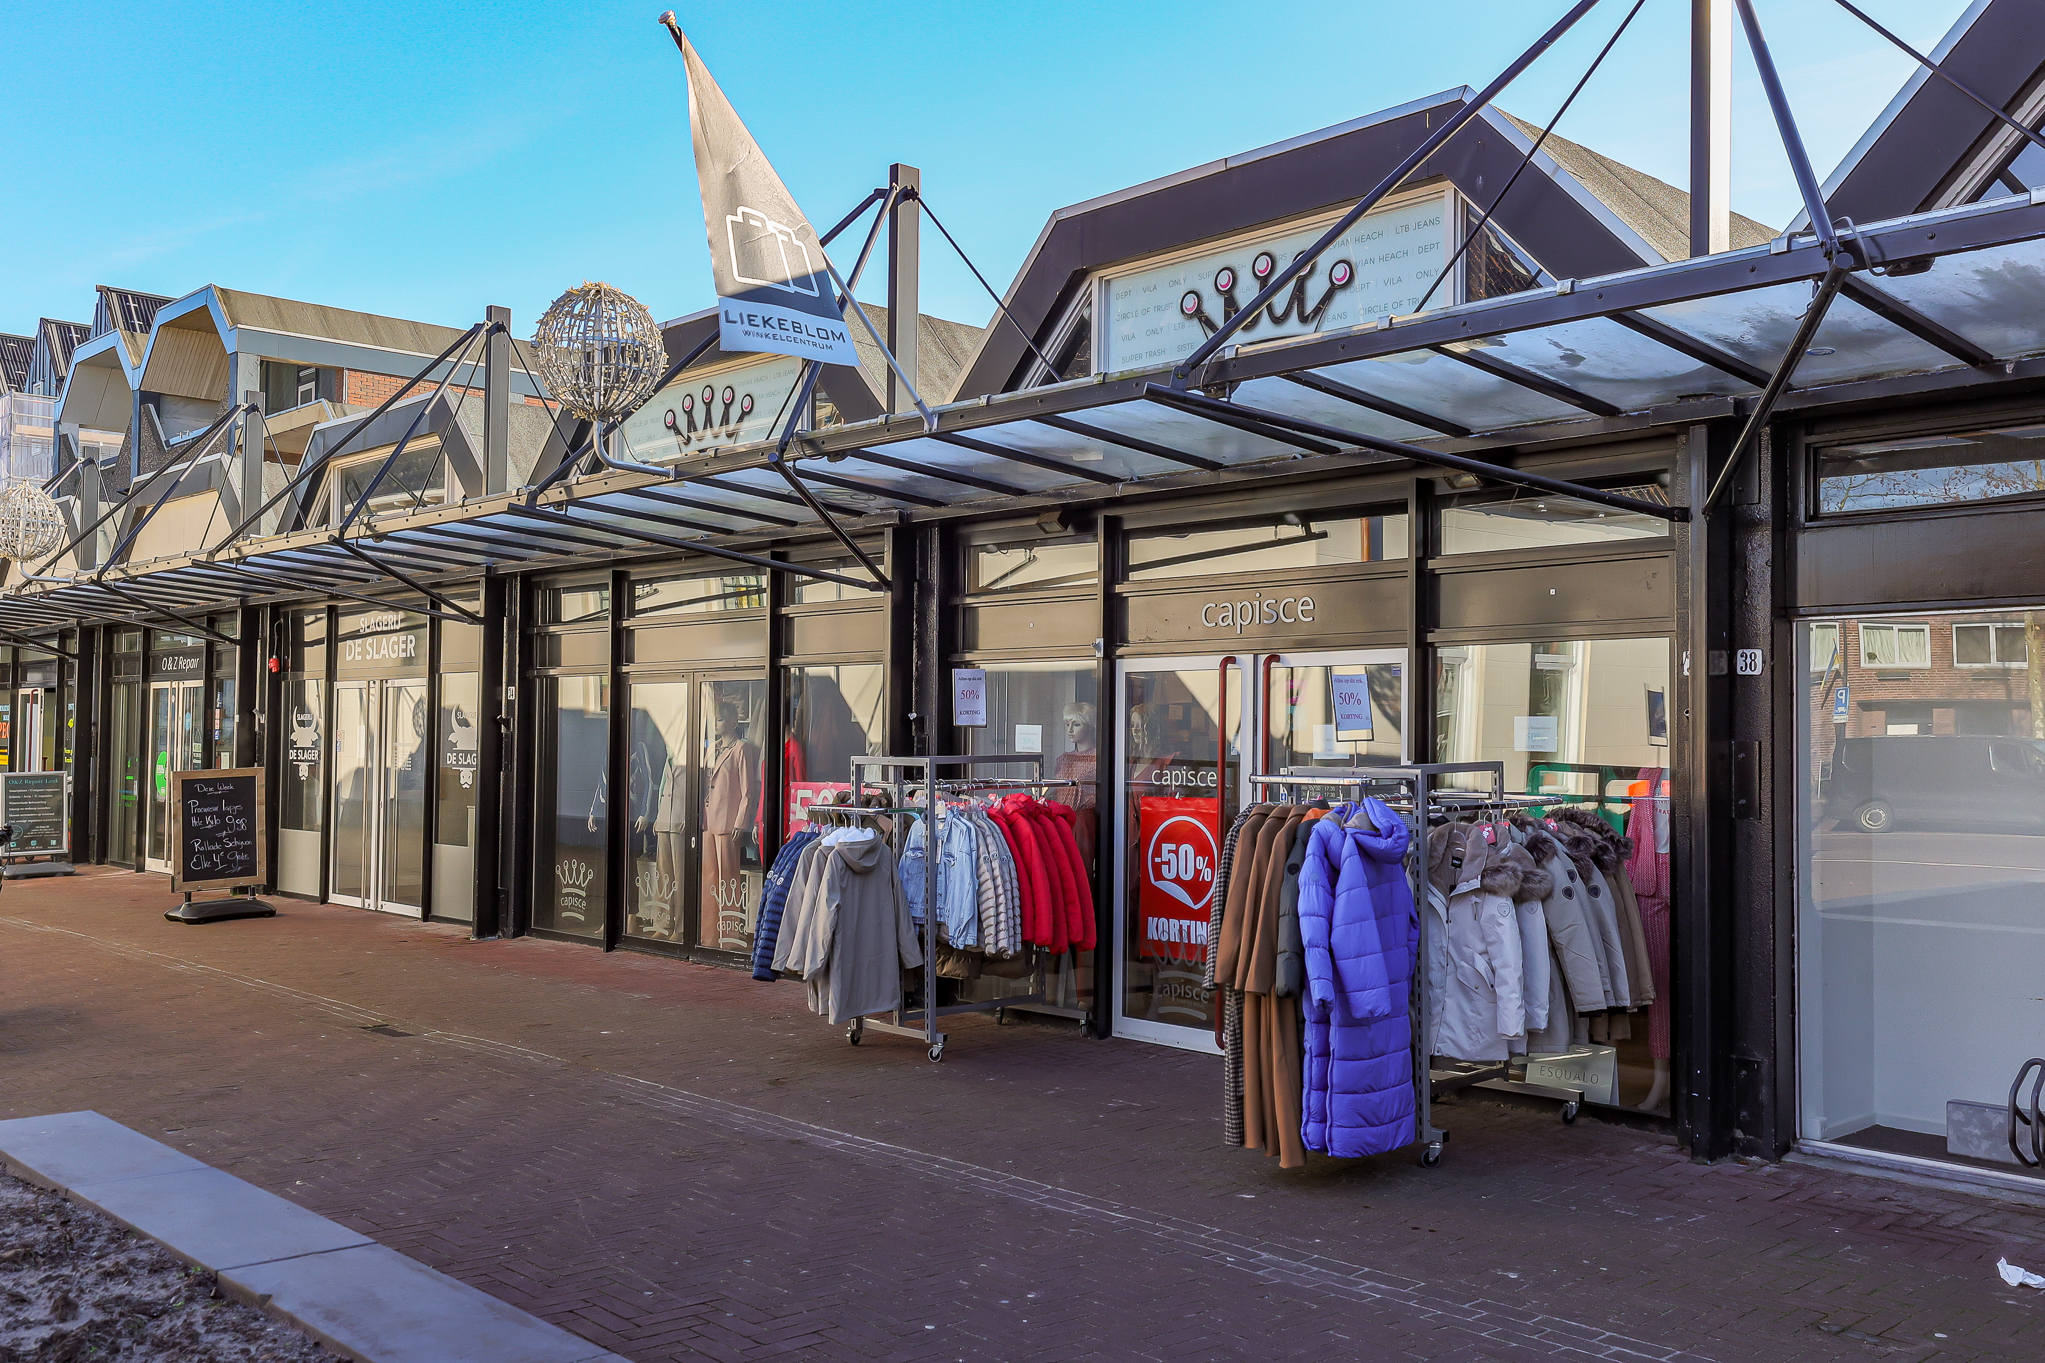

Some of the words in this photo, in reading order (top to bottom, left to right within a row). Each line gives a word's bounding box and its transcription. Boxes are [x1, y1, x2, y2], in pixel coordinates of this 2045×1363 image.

[1395, 224, 1410, 235] LTB
[1412, 216, 1441, 231] JEANS
[1354, 230, 1384, 245] HEACH
[1378, 249, 1409, 264] HEACH
[1417, 242, 1441, 255] DEPT
[1115, 289, 1132, 301] DEPT
[1142, 284, 1158, 294] VILA
[1168, 277, 1188, 288] ONLY
[1349, 282, 1371, 294] DEPT
[1383, 276, 1403, 287] VILA
[1415, 267, 1440, 280] ONLY
[1141, 307, 1151, 316] OF
[1153, 302, 1173, 314] TRUST
[1359, 303, 1389, 317] CIRCLE
[1391, 299, 1404, 310] OF
[724, 309, 846, 343] LIEKEBLOM
[1121, 332, 1136, 342] VILA
[1145, 326, 1164, 337] ONLY
[1173, 321, 1186, 331] LTB
[742, 328, 834, 351] WINKELCENTRUM
[1121, 352, 1143, 364] SUPER
[1145, 348, 1166, 359] TRASH
[359, 613, 401, 633] SLAGERIJ
[1201, 592, 1316, 635] capisce
[345, 639, 363, 661] DE
[365, 634, 416, 661] SLAGER
[178, 656, 200, 672] Repair
[1739, 651, 1758, 673] 38
[960, 689, 980, 700] 50%
[1339, 692, 1362, 706] 50%
[289, 749, 297, 760] DE
[297, 749, 319, 760] SLAGER
[446, 752, 457, 765] DE
[458, 752, 477, 765] SLAG
[24, 778, 43, 786] Repair
[1151, 765, 1217, 791] capisce
[1154, 843, 1212, 882] -50%
[560, 893, 587, 910] capisce
[1147, 916, 1209, 946] KORTIN
[1155, 979, 1210, 1004] capisce
[1539, 1065, 1599, 1085] ESQUALO
